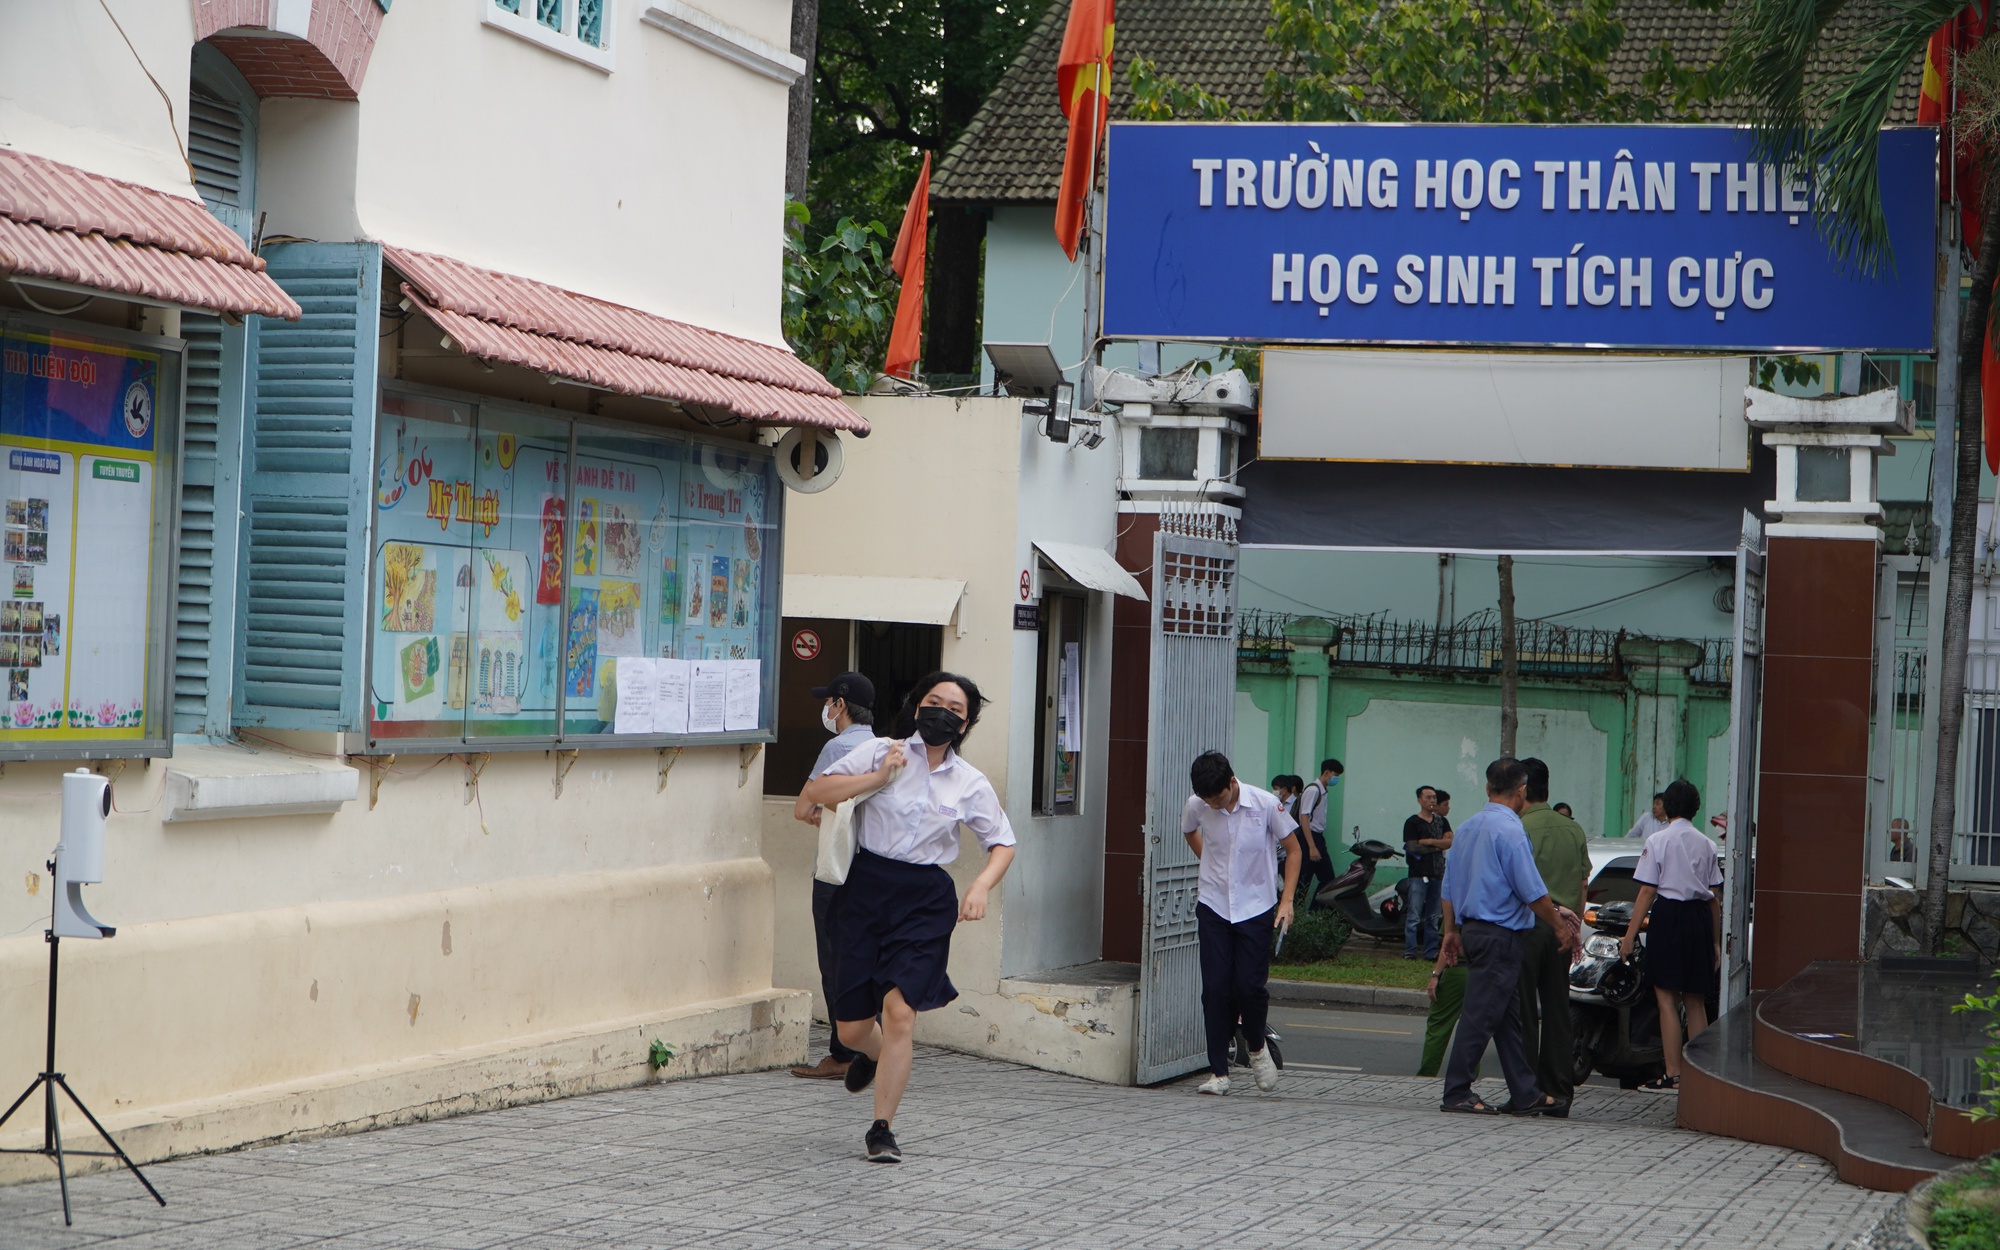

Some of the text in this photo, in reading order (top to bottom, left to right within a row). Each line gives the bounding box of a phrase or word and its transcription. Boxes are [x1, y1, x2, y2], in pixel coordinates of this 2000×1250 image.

[1192, 140, 1399, 210] TRƯỜNG
[1415, 158, 1521, 221] HỌC
[1534, 148, 1676, 211] THÂN
[1271, 242, 1774, 321] HỌC SINH TÍCH CỰC
[4, 349, 96, 388] TIN LIÊN ĐỘI
[563, 463, 599, 488] TANH
[618, 468, 636, 493] TÀI
[427, 479, 454, 531] Mỹ
